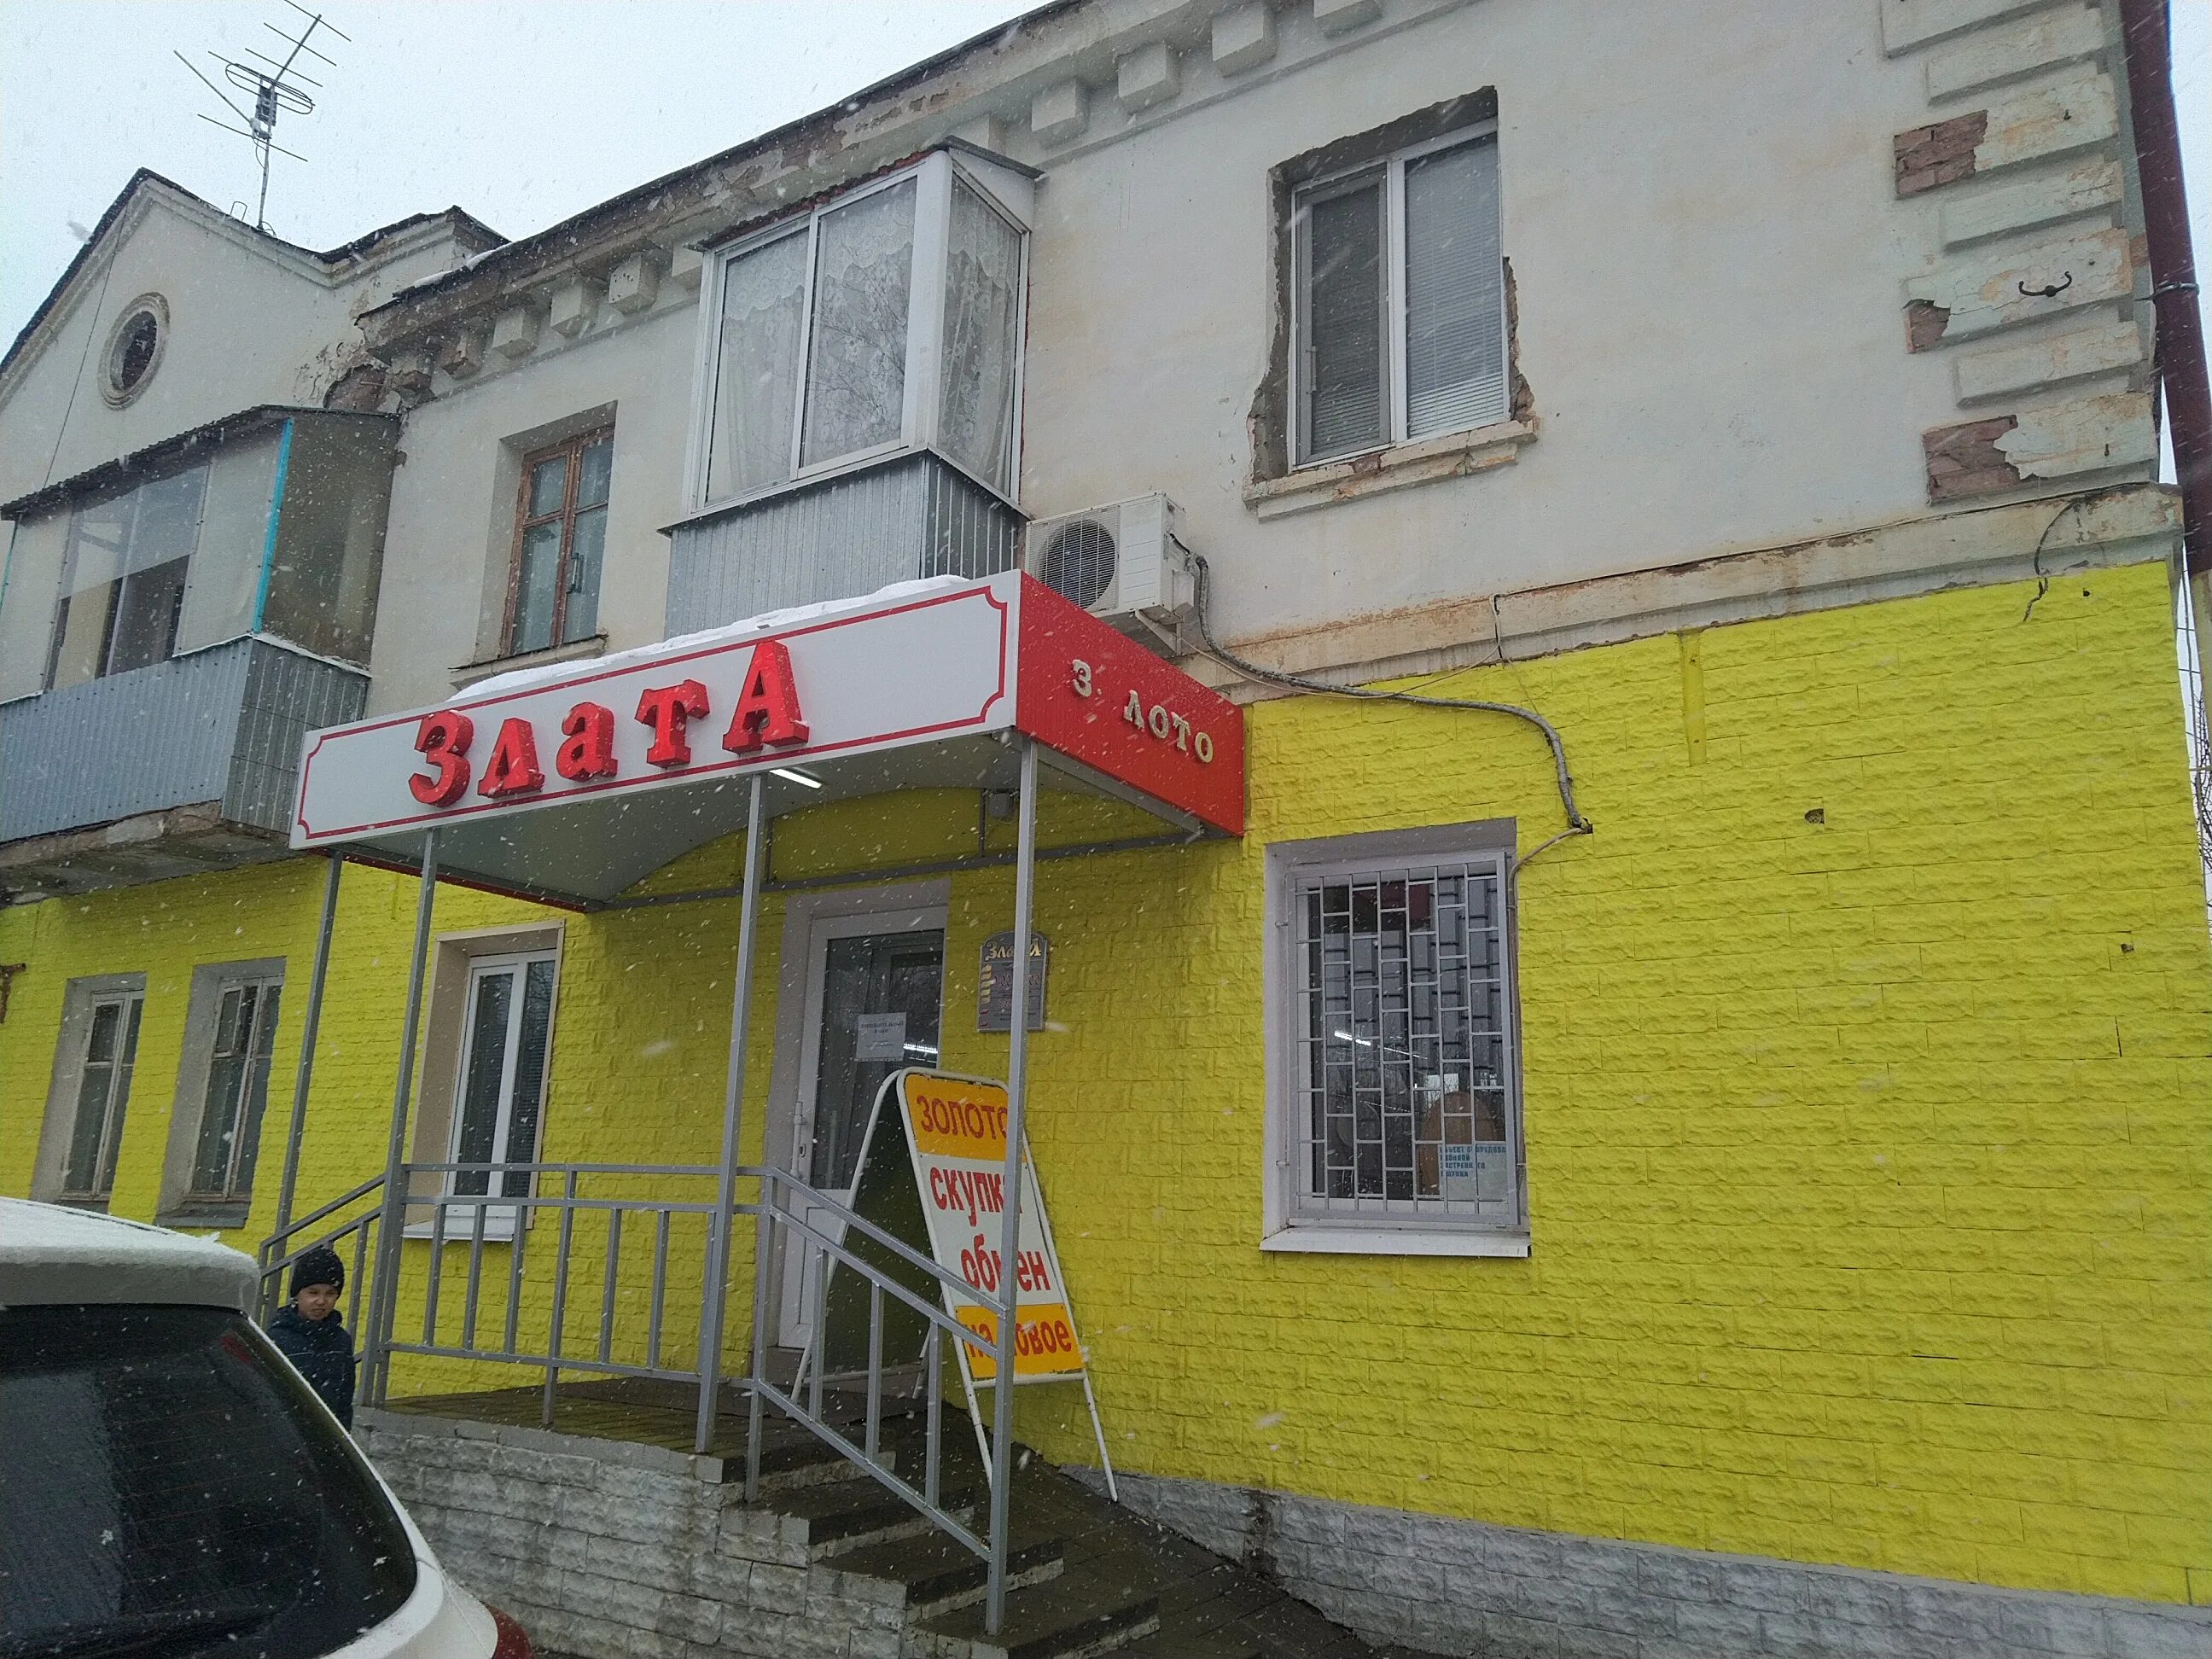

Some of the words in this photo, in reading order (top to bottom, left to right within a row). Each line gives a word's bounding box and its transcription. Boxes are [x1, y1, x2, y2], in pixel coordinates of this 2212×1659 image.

[985, 938, 1042, 961] ЗлаА
[930, 1167, 1023, 1227] скупк
[1013, 1320, 1073, 1357] овое
